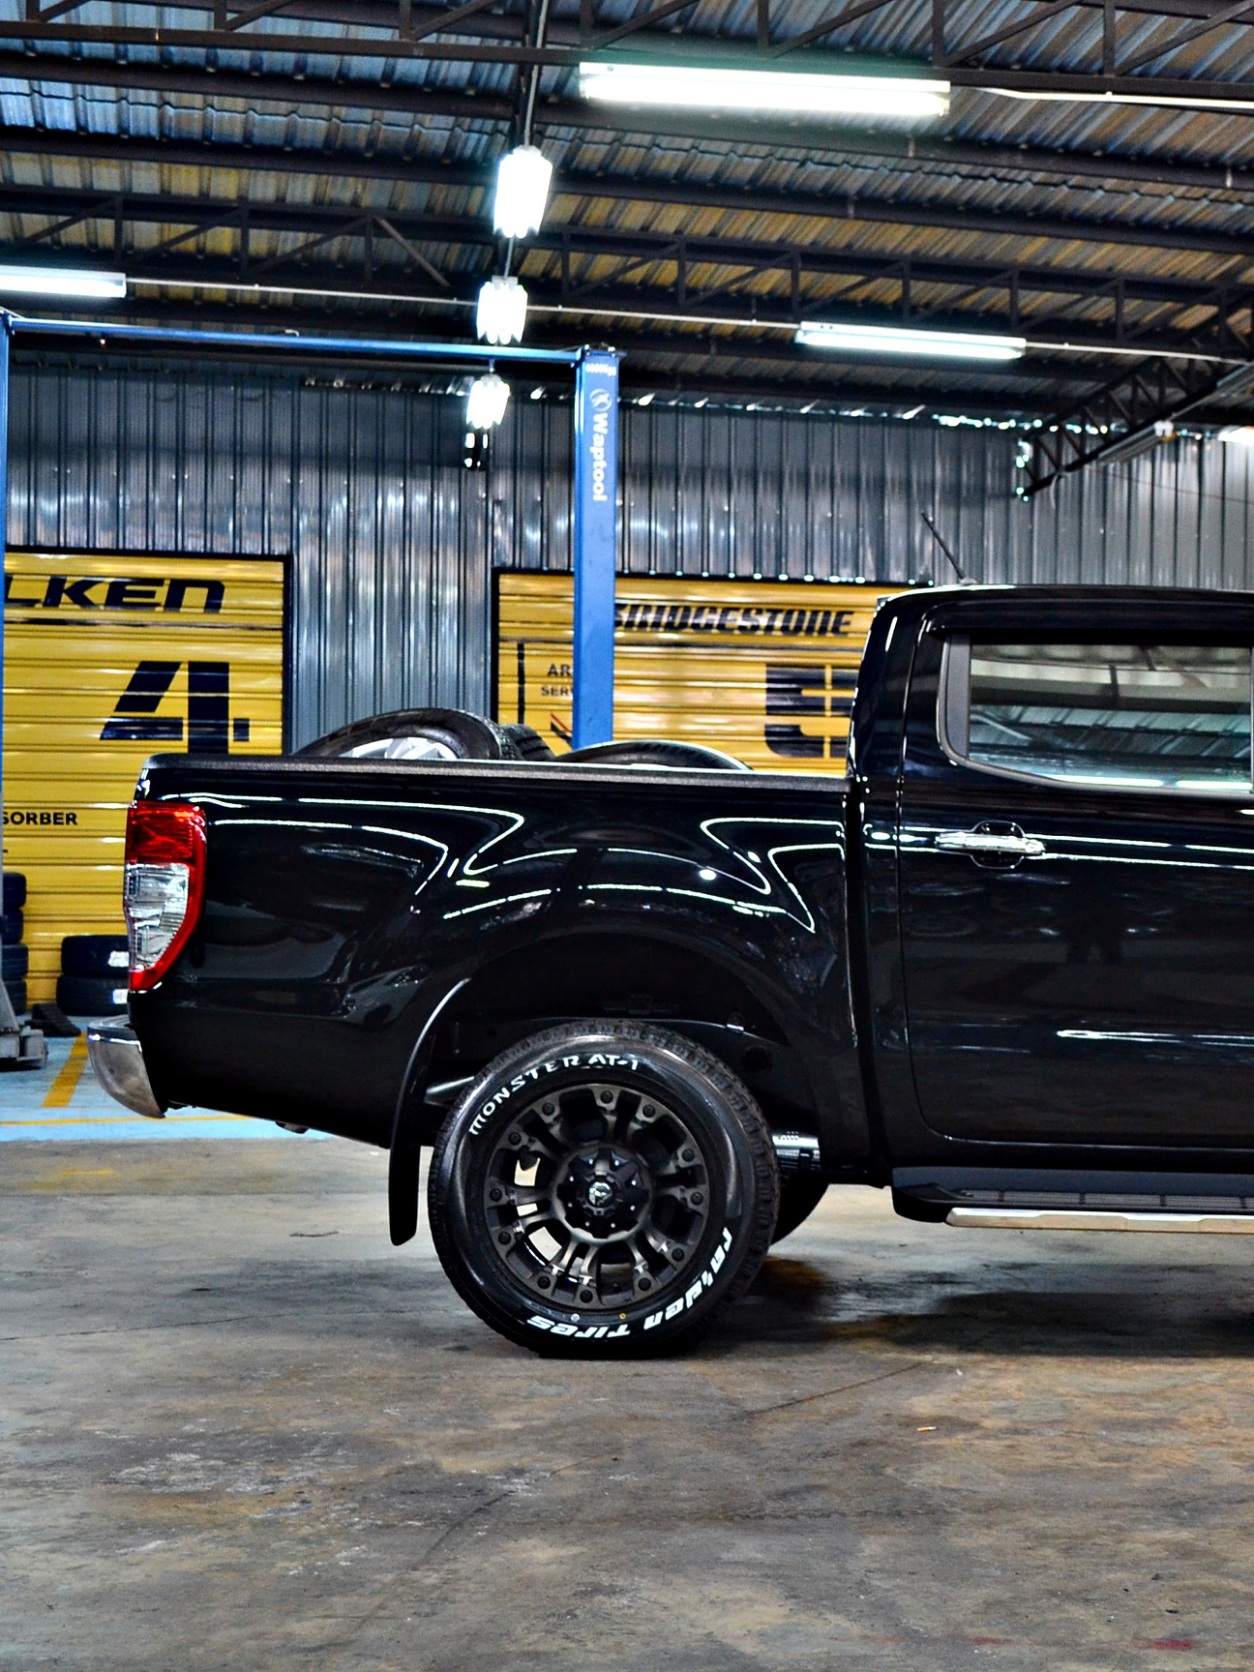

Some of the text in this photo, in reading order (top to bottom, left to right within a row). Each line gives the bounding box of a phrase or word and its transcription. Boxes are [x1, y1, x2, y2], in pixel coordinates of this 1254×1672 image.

[590, 413, 609, 501] Waptool
[541, 686, 573, 697] SER
[468, 1053, 639, 1136] MONSTER AT-1
